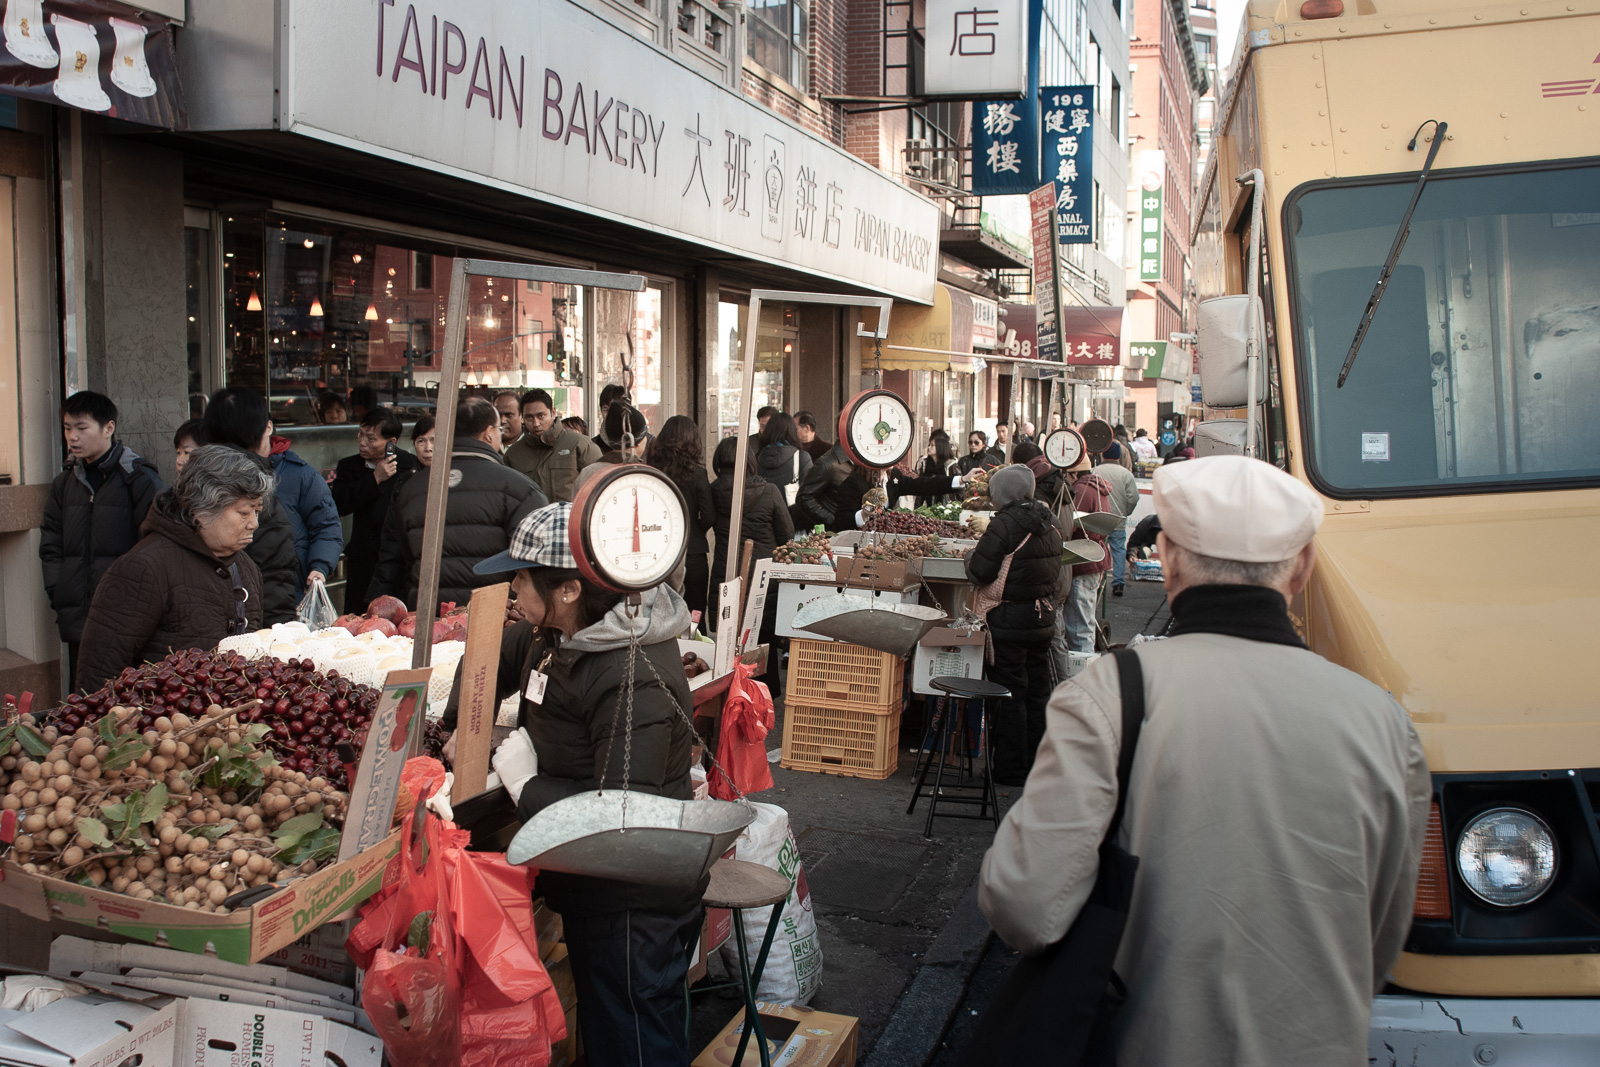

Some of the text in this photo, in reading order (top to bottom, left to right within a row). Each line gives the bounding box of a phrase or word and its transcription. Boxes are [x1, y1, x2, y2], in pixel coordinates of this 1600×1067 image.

[950, 7, 999, 56] 店
[377, 0, 665, 178] TAIPAN BAKERY
[1052, 94, 1083, 107] 196
[983, 103, 1021, 174] 務樓
[682, 112, 843, 249] 大班 餅店
[1056, 136, 1079, 211] 西藥房
[854, 207, 932, 274] TAIPAN BAKERY
[1057, 213, 1083, 224] ANAL
[1058, 225, 1090, 236] RMACY
[920, 332, 945, 346] ART
[472, 692, 478, 703] AT
[475, 721, 481, 735] DO
[478, 664, 486, 697] FREEZE
[357, 706, 395, 853] POMEGRAN
[373, 776, 393, 846] ULTIMAT
[292, 868, 356, 935] Driscoll's
[782, 916, 798, 939] 특
[301, 953, 328, 969] 2011
[138, 1030, 151, 1046] WT.
[195, 1026, 207, 1067] PRODU
[241, 1022, 253, 1067] HOMES
[252, 1014, 265, 1059] DOUBLE
[265, 1044, 275, 1067] DIST
[301, 1032, 313, 1055] WT.
